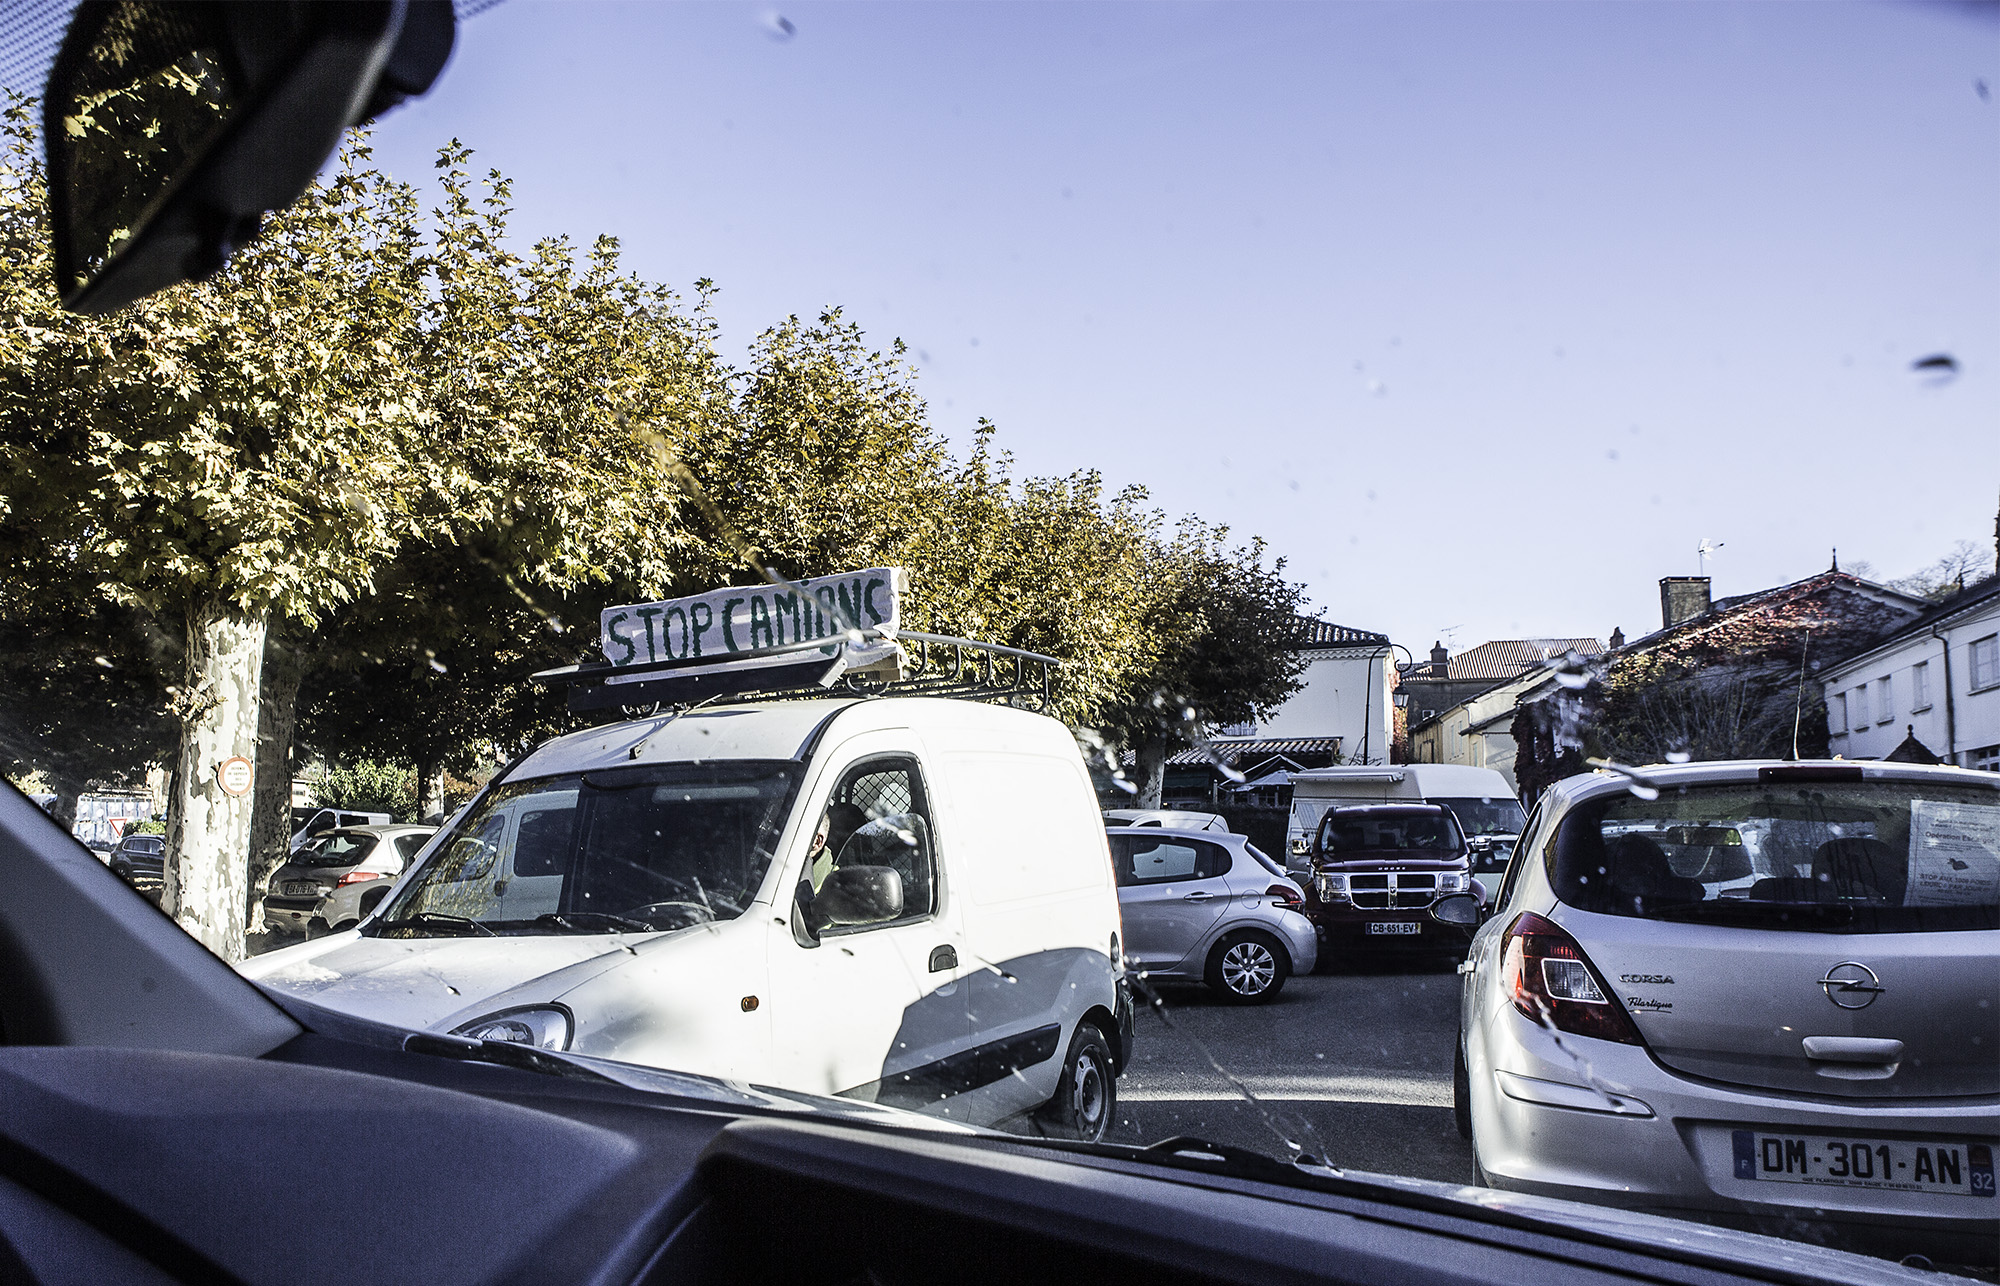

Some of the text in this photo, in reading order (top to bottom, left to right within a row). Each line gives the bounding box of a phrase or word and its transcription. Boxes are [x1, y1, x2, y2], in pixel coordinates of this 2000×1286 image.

[608, 602, 713, 667] STOP
[1372, 923, 1414, 933] CB-651-EV
[1619, 974, 1675, 984] CORSA
[1741, 1159, 1749, 1169] F
[1761, 1137, 1962, 1185] DM-301-AN
[1973, 1172, 1994, 1190] 32
